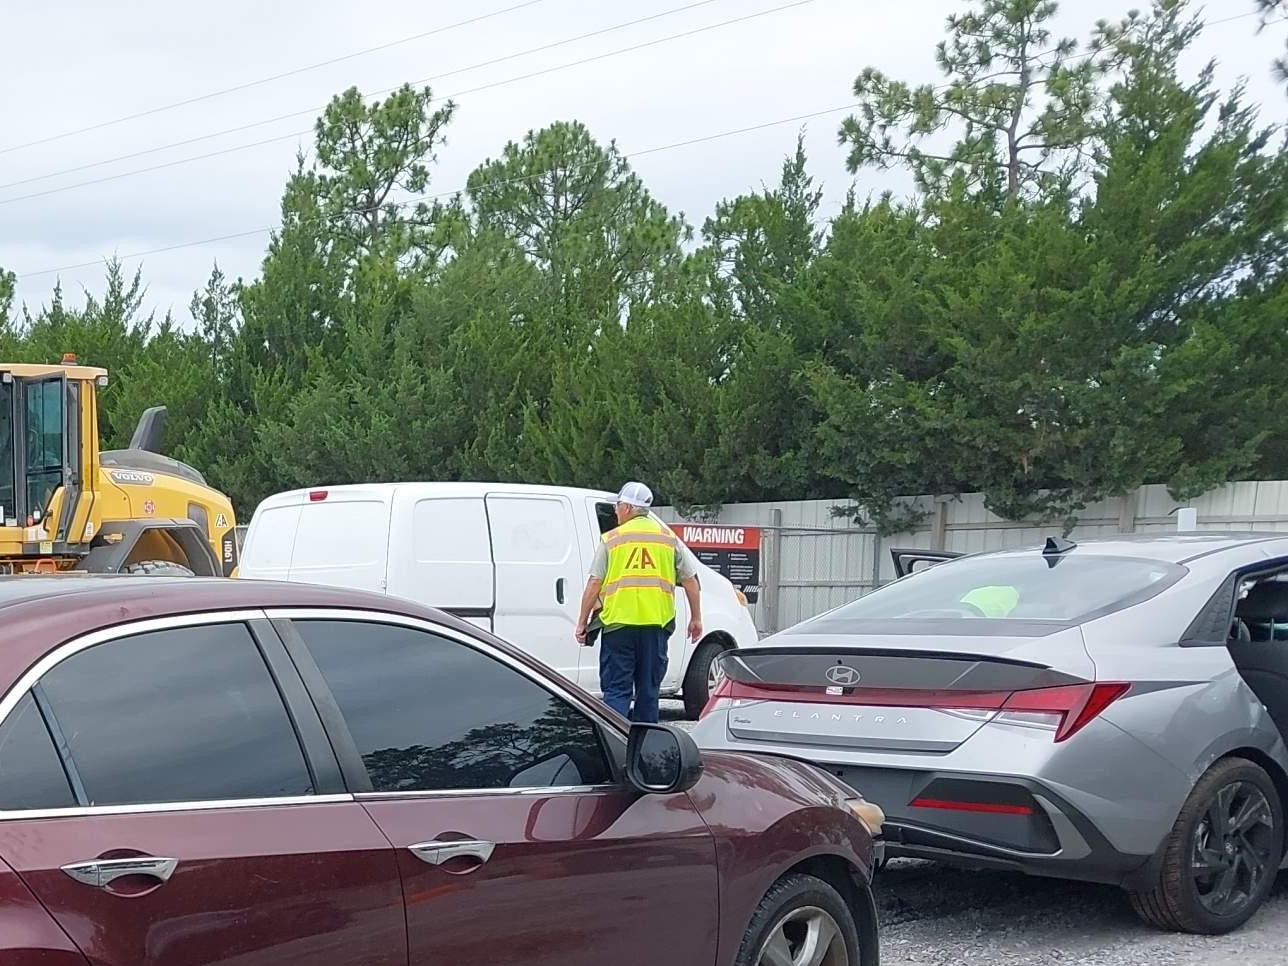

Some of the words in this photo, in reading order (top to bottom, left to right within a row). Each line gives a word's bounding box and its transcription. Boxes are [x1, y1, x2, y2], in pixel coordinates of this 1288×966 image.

[113, 471, 153, 482] VOLVO
[683, 526, 744, 544] WARNING
[773, 709, 908, 725] ELANTRA
